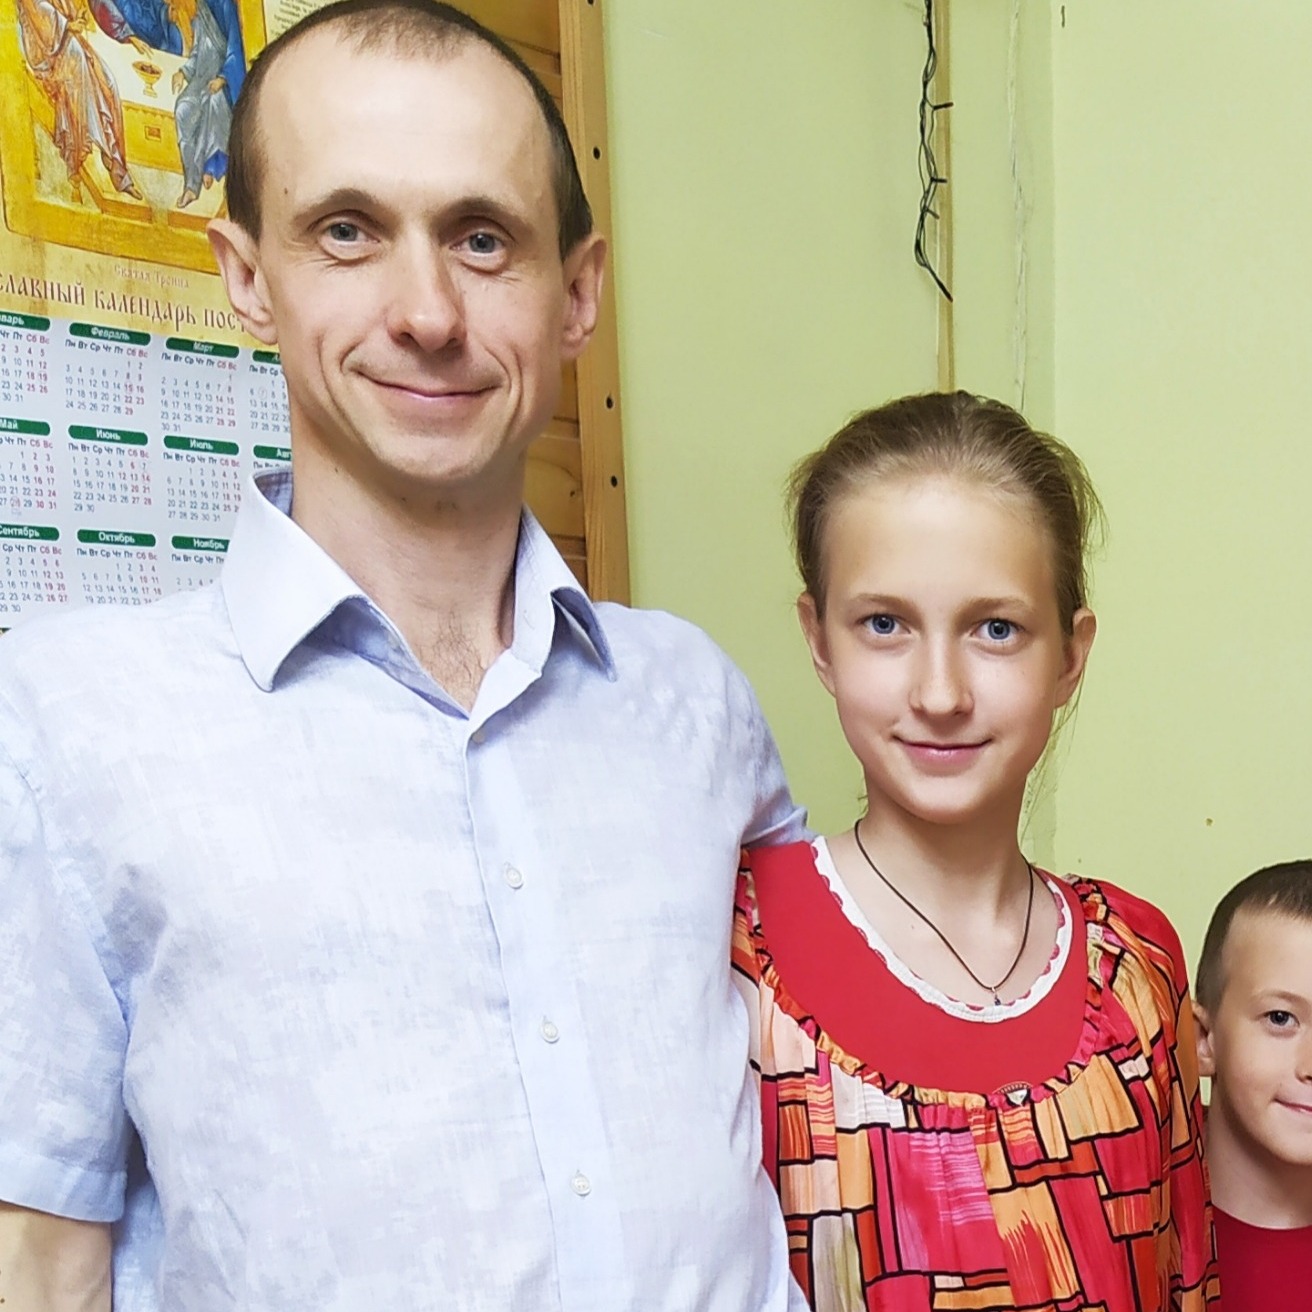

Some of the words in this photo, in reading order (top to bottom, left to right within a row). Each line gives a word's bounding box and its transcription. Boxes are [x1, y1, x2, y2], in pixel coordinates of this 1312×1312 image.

[91, 326, 131, 341] Февраль
[193, 342, 214, 352] Март
[96, 428, 121, 440] Июнь
[190, 439, 213, 450] Июль
[98, 531, 135, 545] Октябрь
[193, 538, 225, 550] Ноябрь
